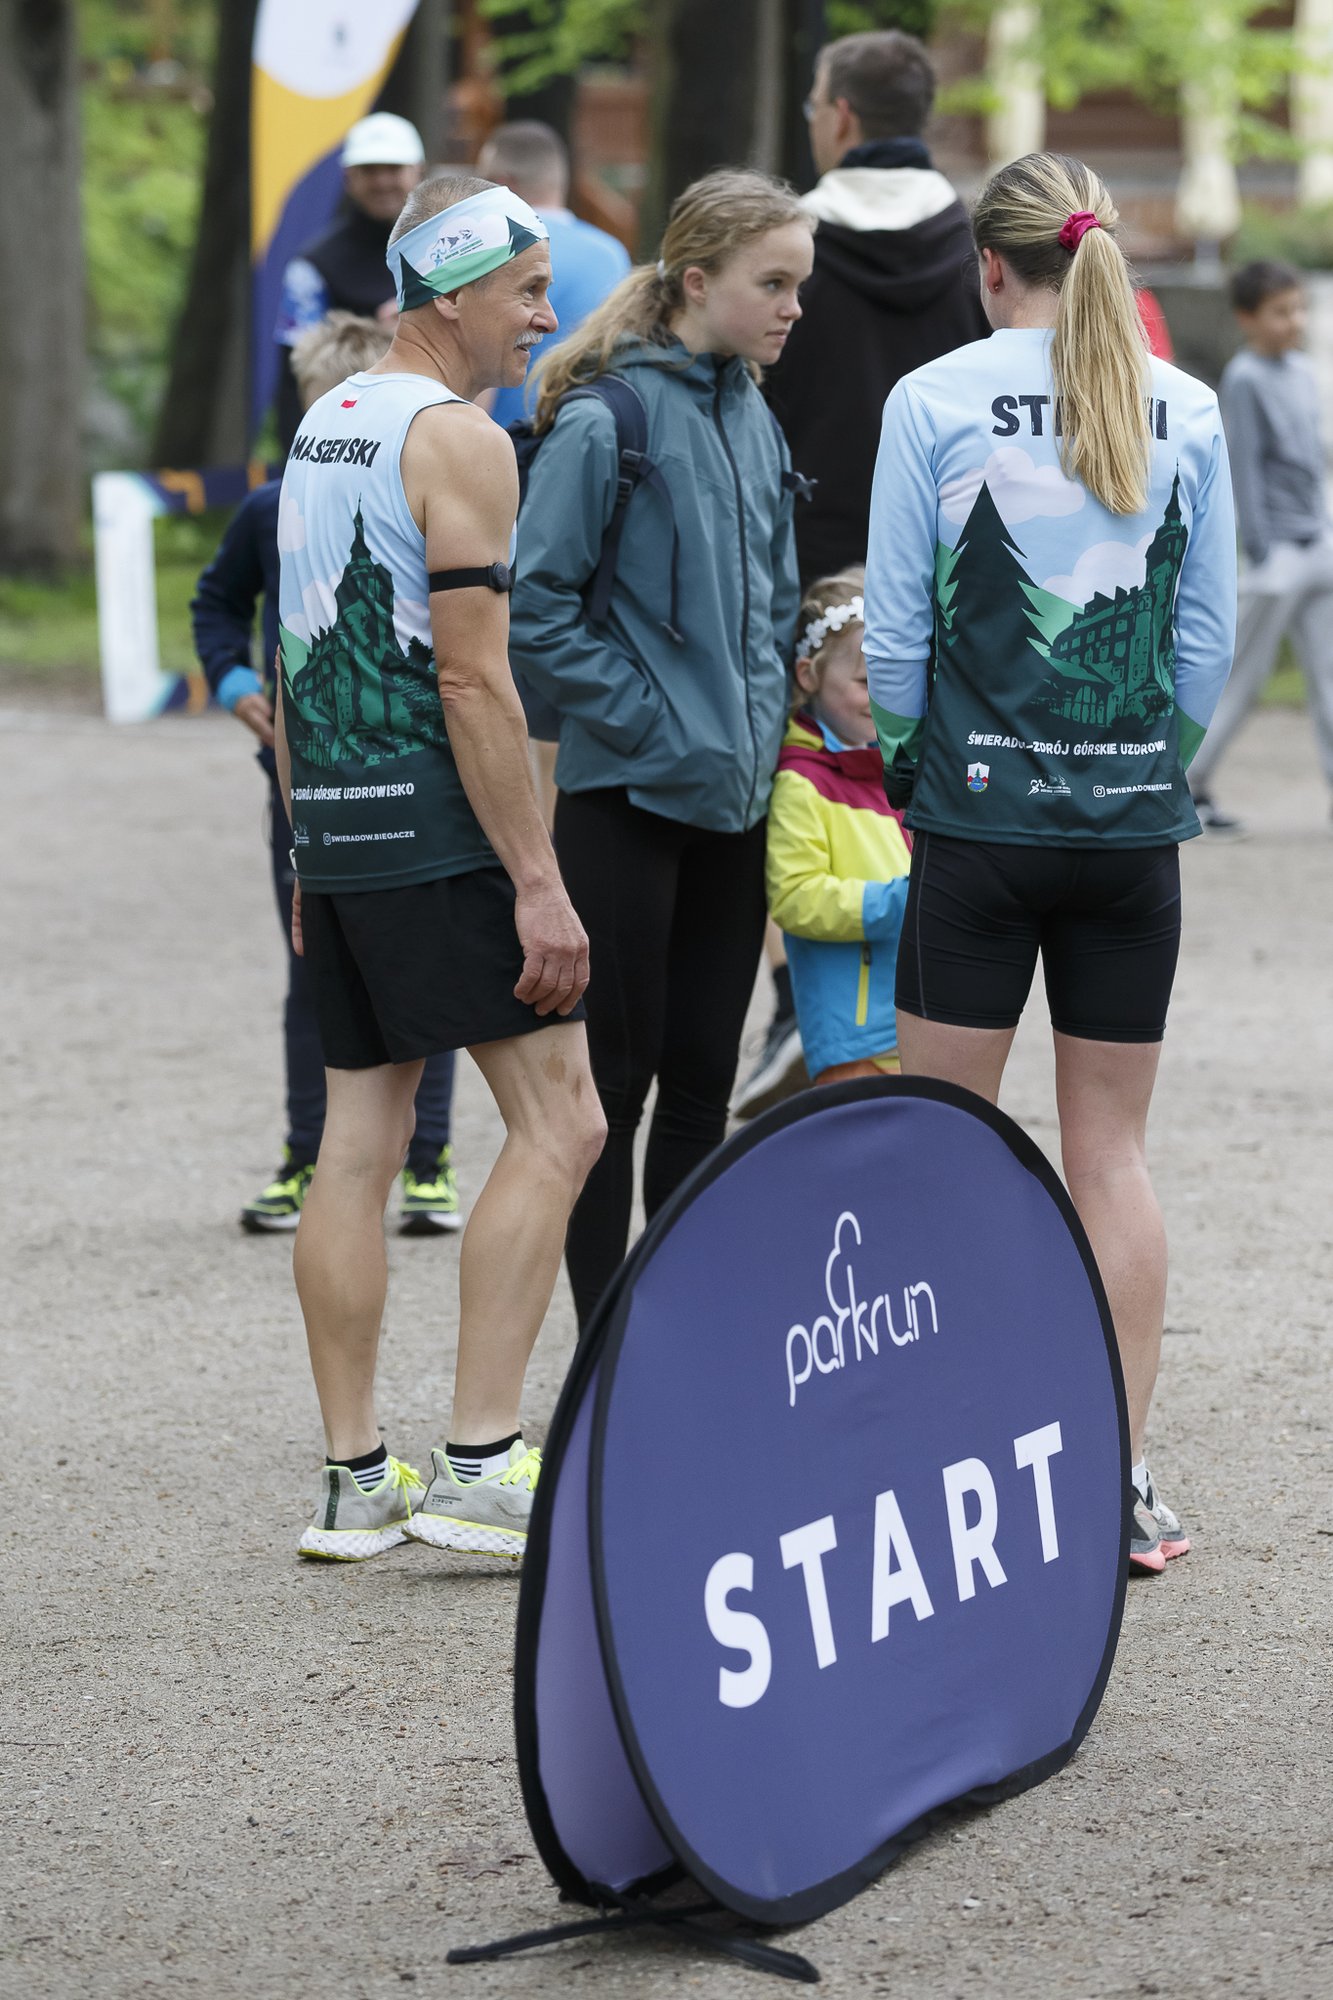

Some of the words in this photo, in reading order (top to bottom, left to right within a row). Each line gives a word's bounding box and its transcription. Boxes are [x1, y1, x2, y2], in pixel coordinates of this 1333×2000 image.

[1073, 740, 1117, 756] GÓRSKIE
[343, 782, 415, 800] UZDROWISKO
[331, 830, 415, 843] SWIERADOW.BIEGACZE
[786, 1211, 939, 1407] parkrun
[704, 1420, 1063, 1708] START
